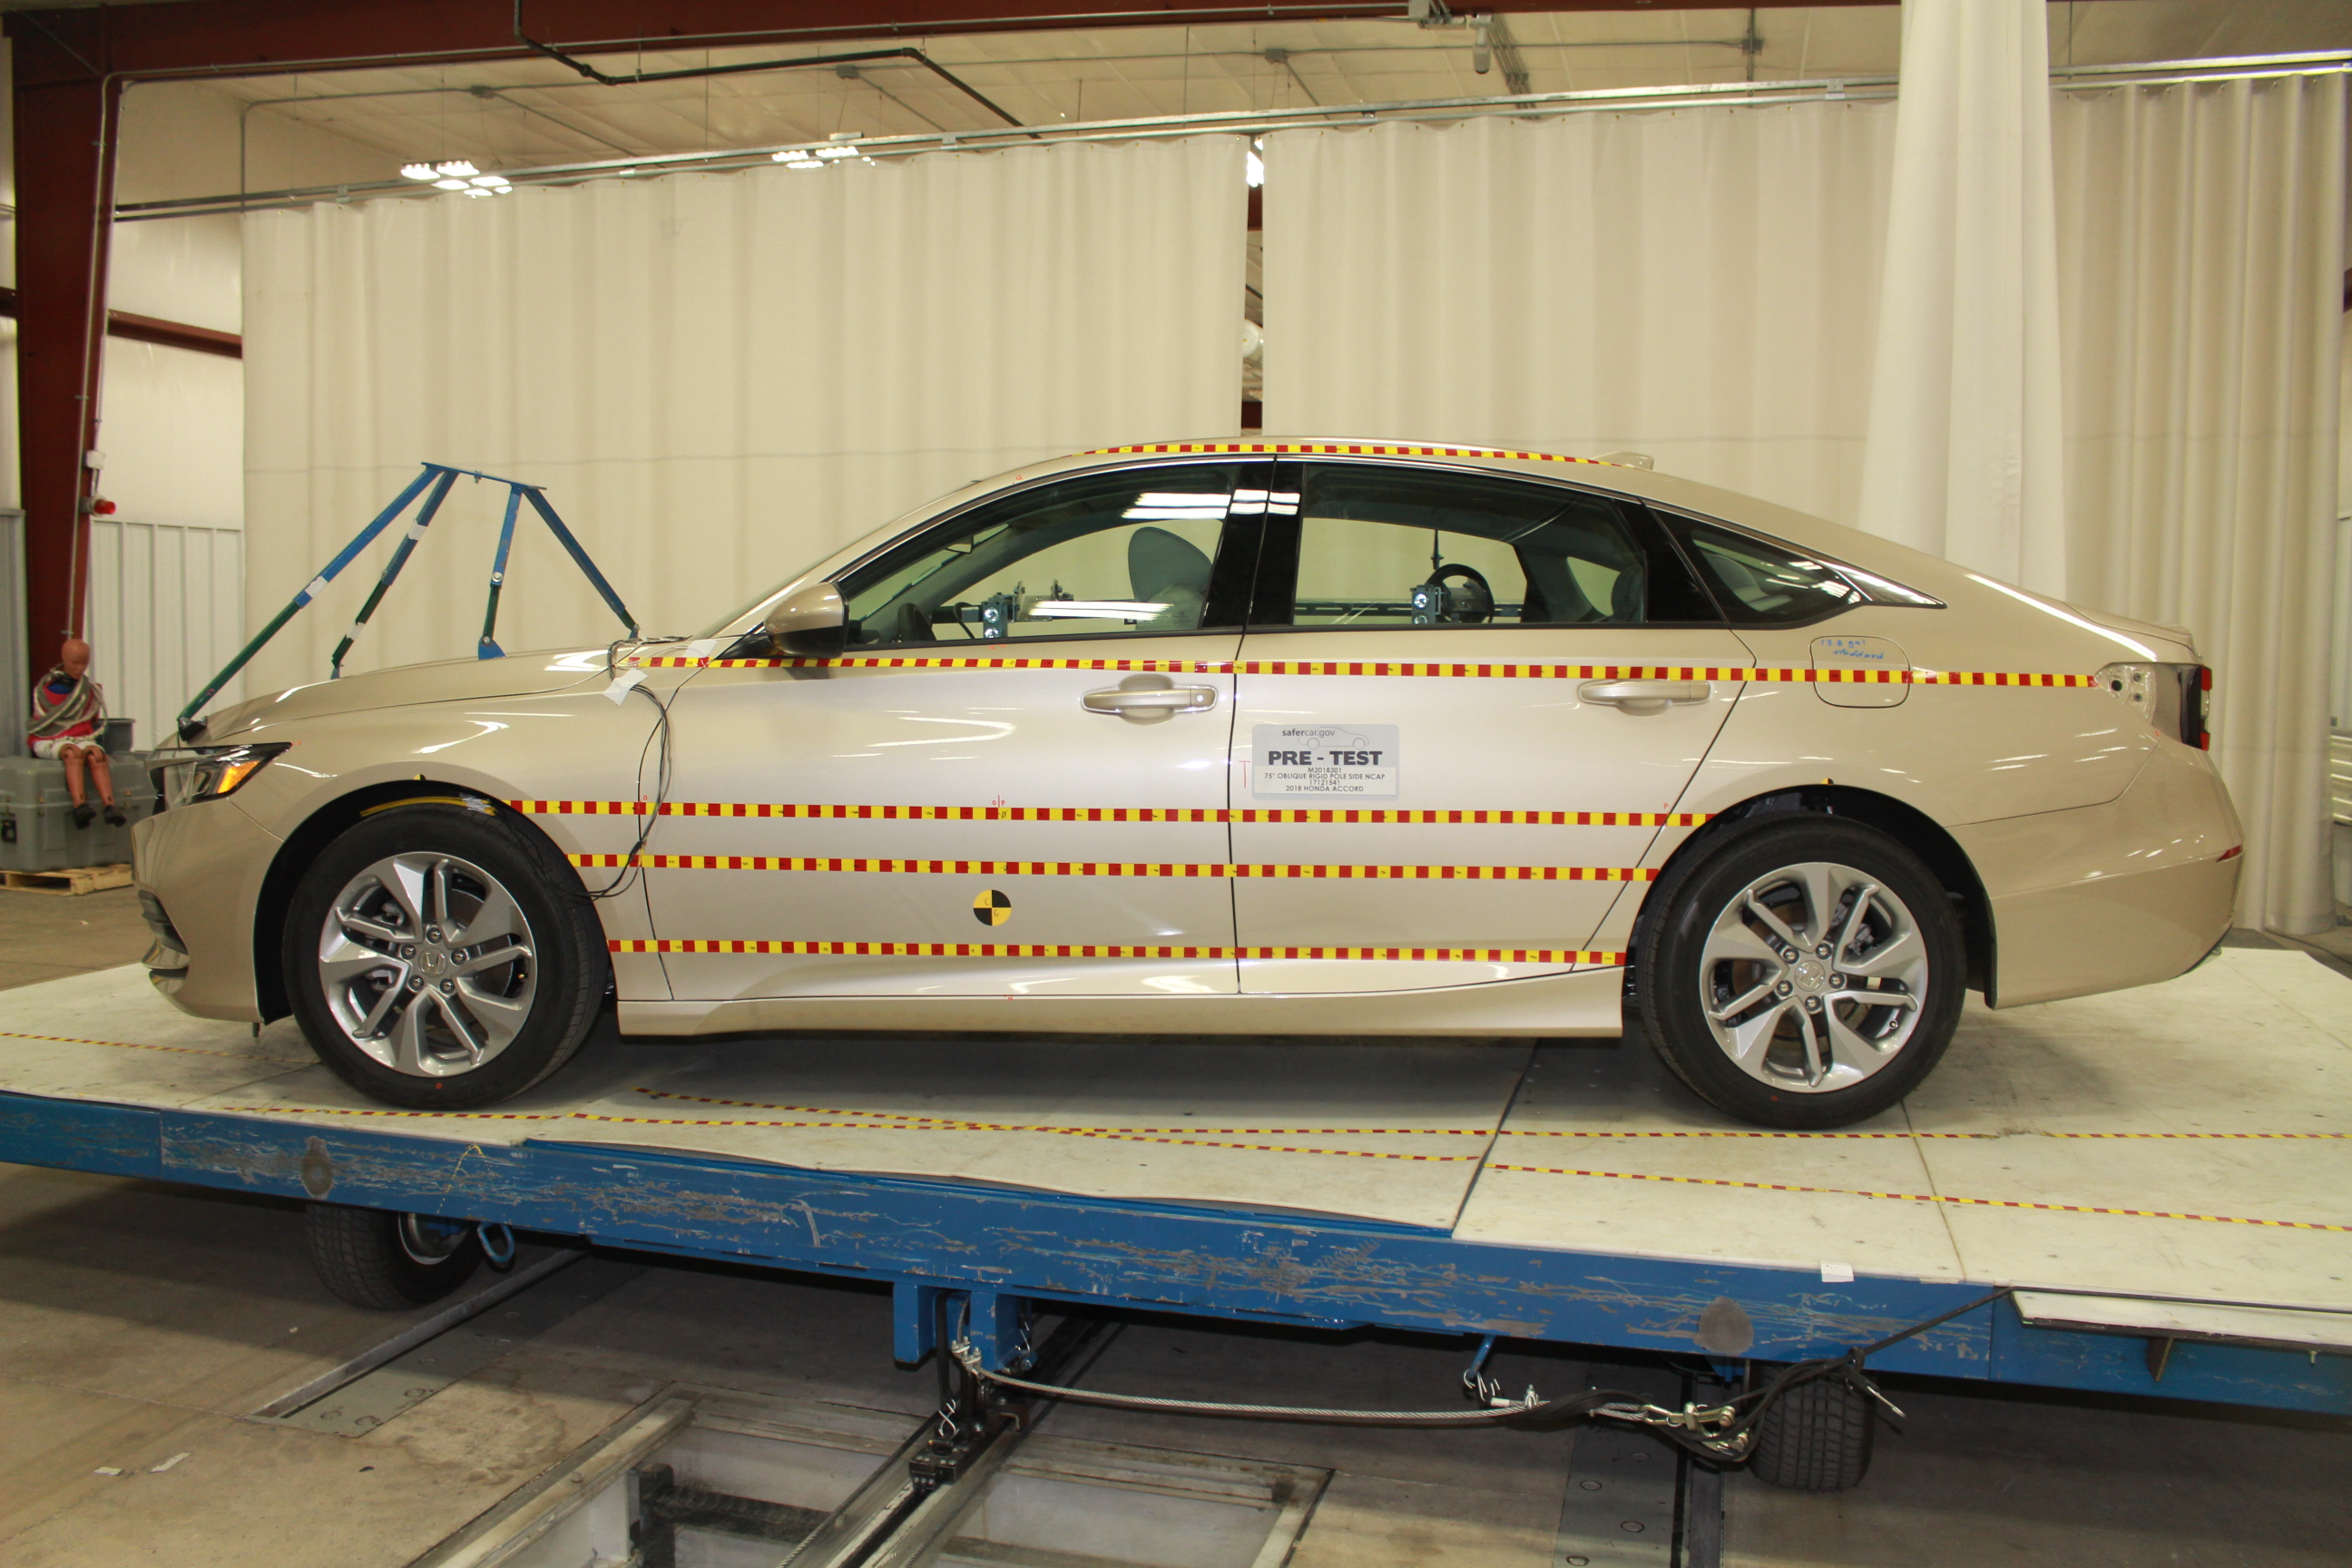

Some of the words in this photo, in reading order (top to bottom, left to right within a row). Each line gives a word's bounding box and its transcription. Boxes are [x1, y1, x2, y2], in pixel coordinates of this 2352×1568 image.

[1282, 728, 1336, 738] safercar.gov
[1269, 750, 1312, 766] PRE
[1329, 750, 1383, 766] TEST
